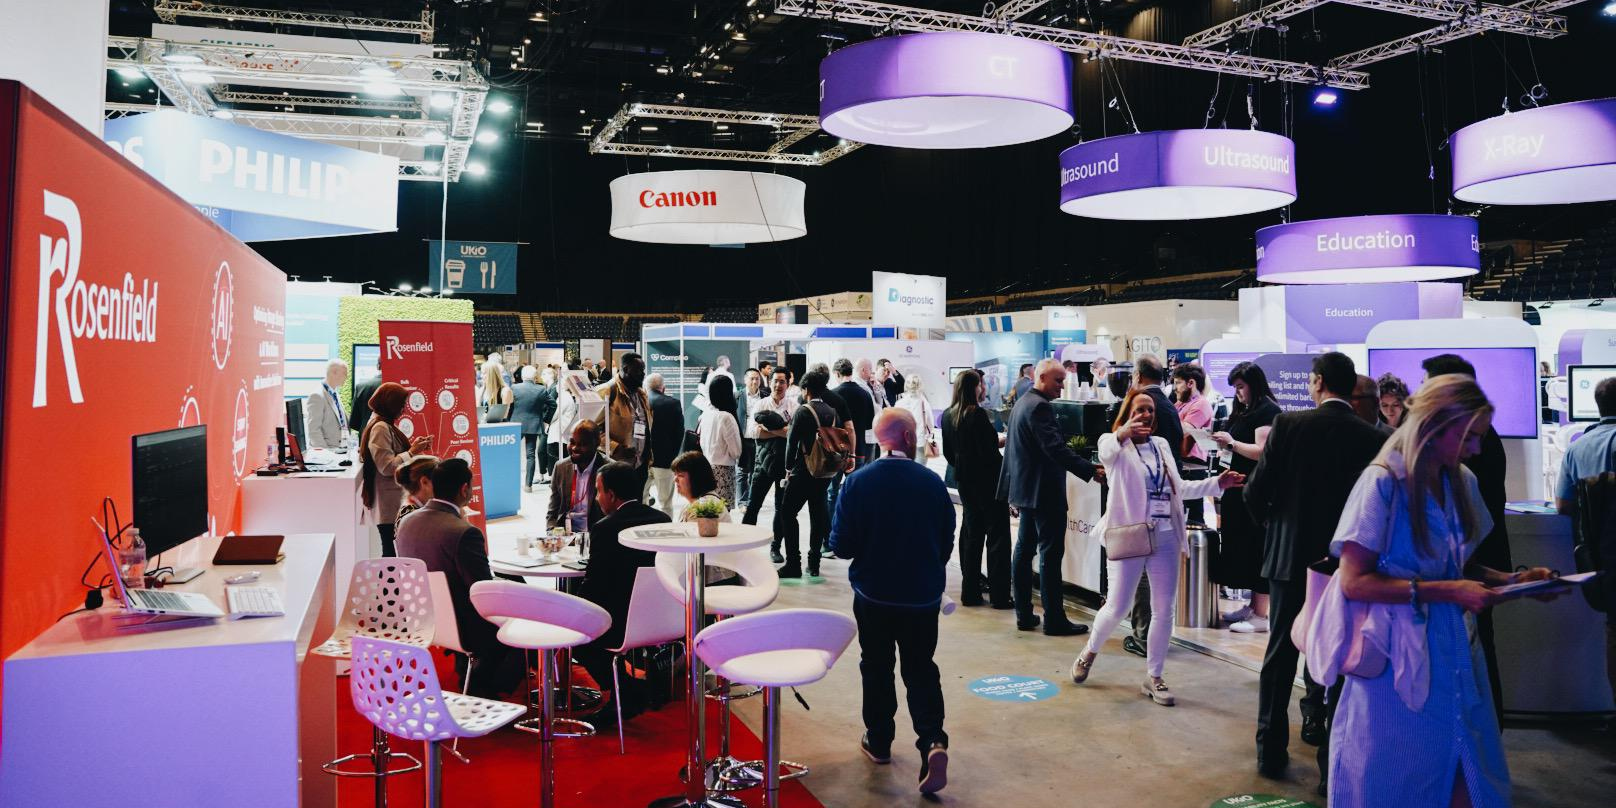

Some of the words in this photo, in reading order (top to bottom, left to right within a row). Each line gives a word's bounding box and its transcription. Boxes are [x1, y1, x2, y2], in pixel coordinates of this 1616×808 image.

[989, 56, 1016, 78] CT
[1485, 133, 1545, 161] X-Ray
[203, 138, 352, 201] PHILIP
[1205, 146, 1289, 174] Ultrasound
[639, 190, 717, 208] Canon
[1317, 231, 1416, 252] Education
[32, 189, 158, 408] Rosenfield
[216, 290, 229, 340] AI
[1325, 308, 1374, 317] Education
[386, 335, 433, 360] Rosenfield
[1280, 371, 1292, 380] Sign
[1284, 381, 1293, 389] list
[1274, 392, 1299, 400] nlimited
[481, 434, 516, 446] PHILIPS
